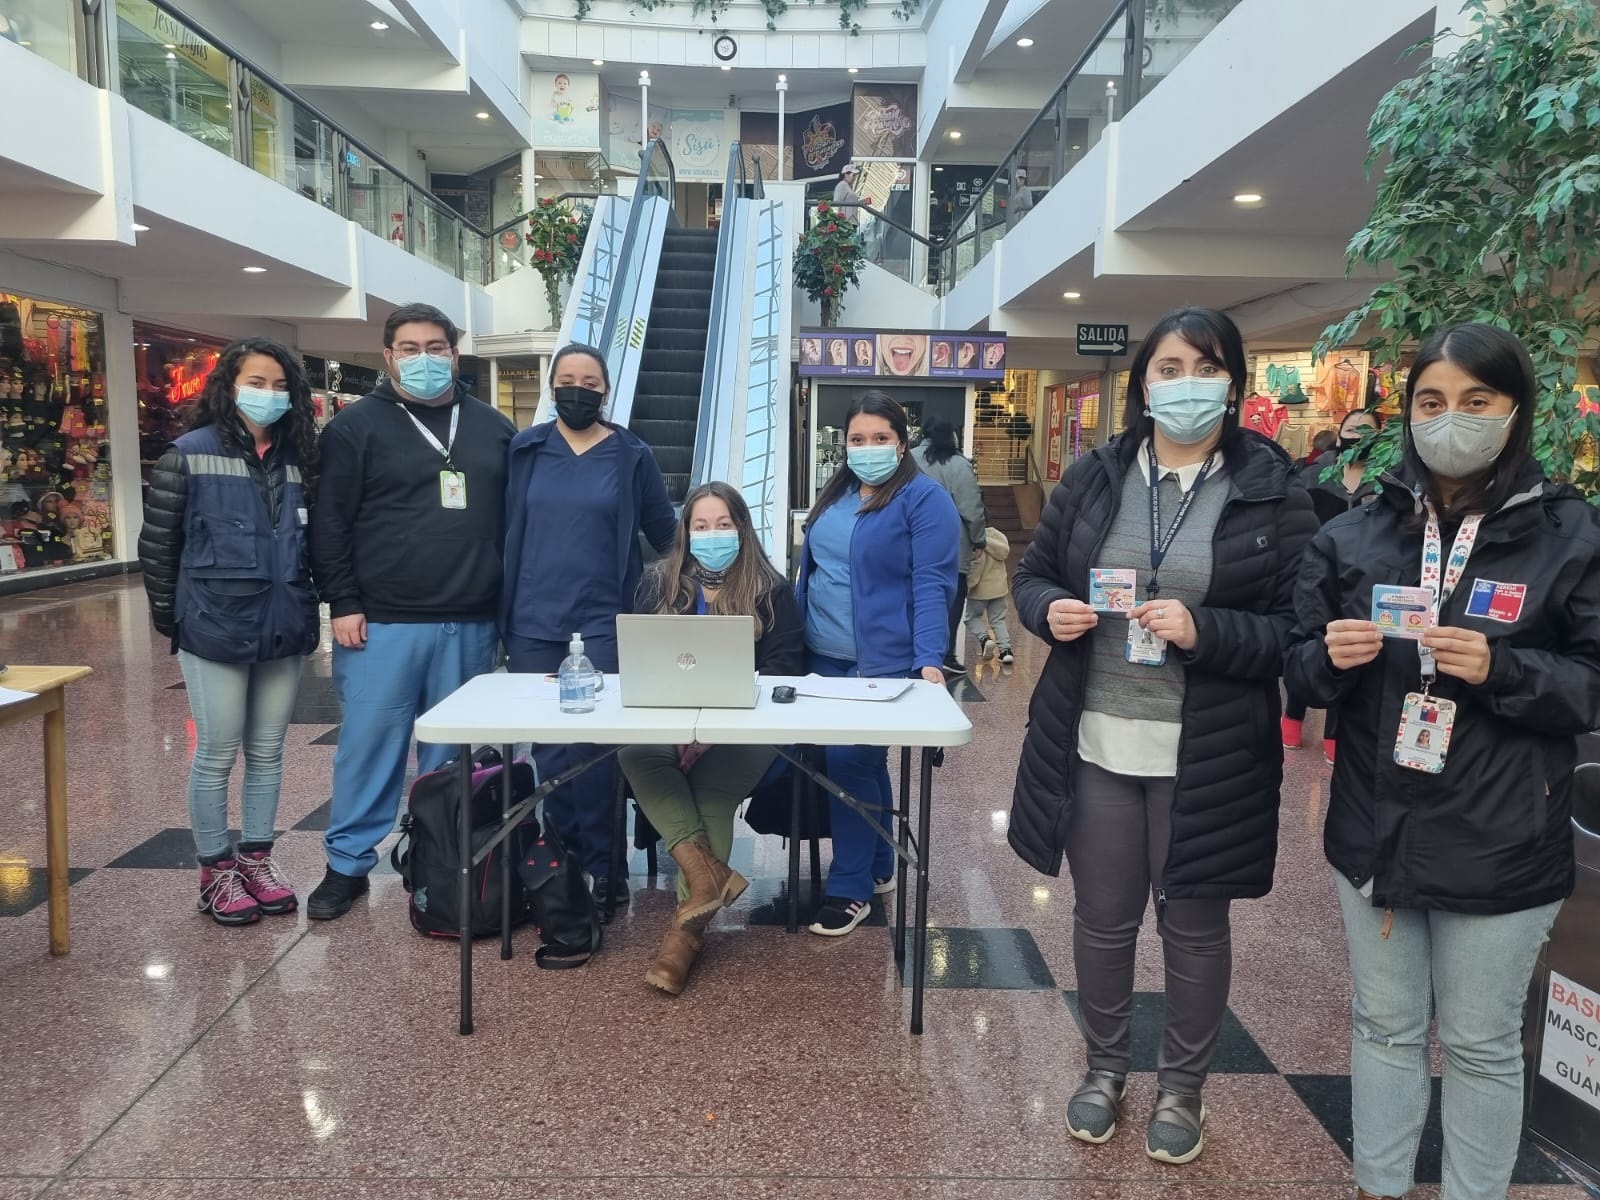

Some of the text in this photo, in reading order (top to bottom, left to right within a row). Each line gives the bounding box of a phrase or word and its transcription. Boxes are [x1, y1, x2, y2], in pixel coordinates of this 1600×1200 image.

[1079, 326, 1126, 342] SALIDA
[1551, 982, 1600, 1023] BAS
[1547, 1009, 1600, 1051] MASC
[1586, 1055, 1595, 1068] Y
